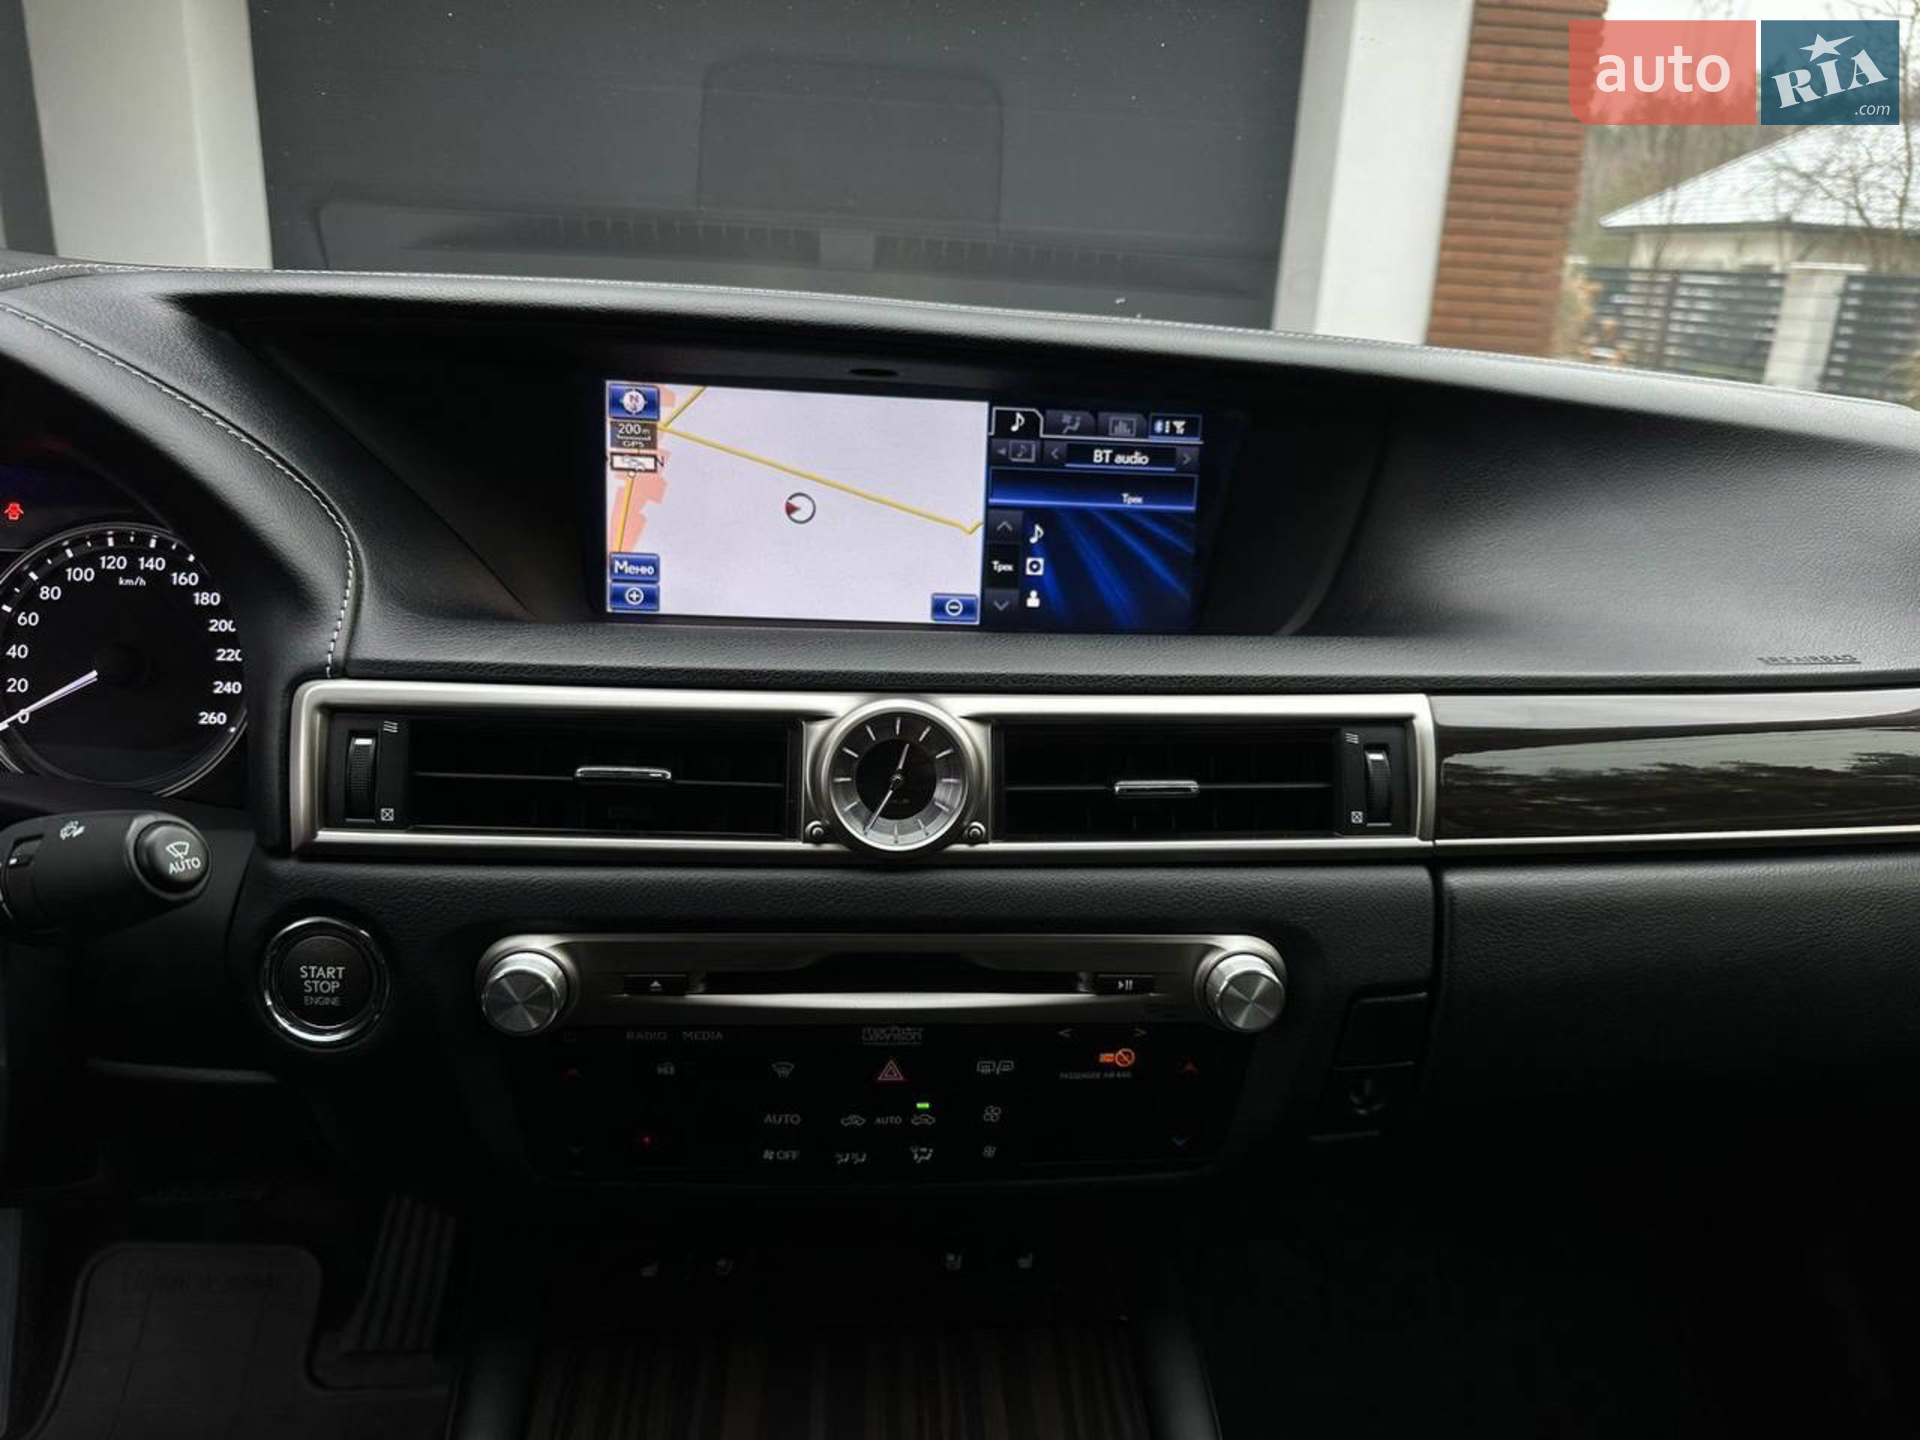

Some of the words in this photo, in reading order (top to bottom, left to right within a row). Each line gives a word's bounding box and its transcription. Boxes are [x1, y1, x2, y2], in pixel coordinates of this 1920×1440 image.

[618, 423, 641, 435] 200
[1093, 449, 1113, 463] BT
[1114, 451, 1149, 466] audio
[100, 557, 127, 570] 120
[138, 558, 166, 571] 140
[614, 560, 655, 575] Меню
[66, 568, 95, 582] 100
[118, 576, 146, 586] km/h
[171, 572, 199, 585] 160
[39, 586, 62, 600] 80
[193, 592, 221, 605] 180
[17, 612, 39, 626] 60
[6, 644, 29, 659] 40
[6, 678, 29, 693] 20
[212, 682, 242, 694] 240
[198, 711, 227, 725] 260
[168, 857, 201, 875] AUTO
[300, 965, 346, 979] START
[303, 980, 340, 993] STOP
[681, 1031, 724, 1041] MEDIA
[763, 1113, 801, 1126] AUTO
[874, 1115, 903, 1126] AUTO
[776, 1150, 801, 1161] OFF
